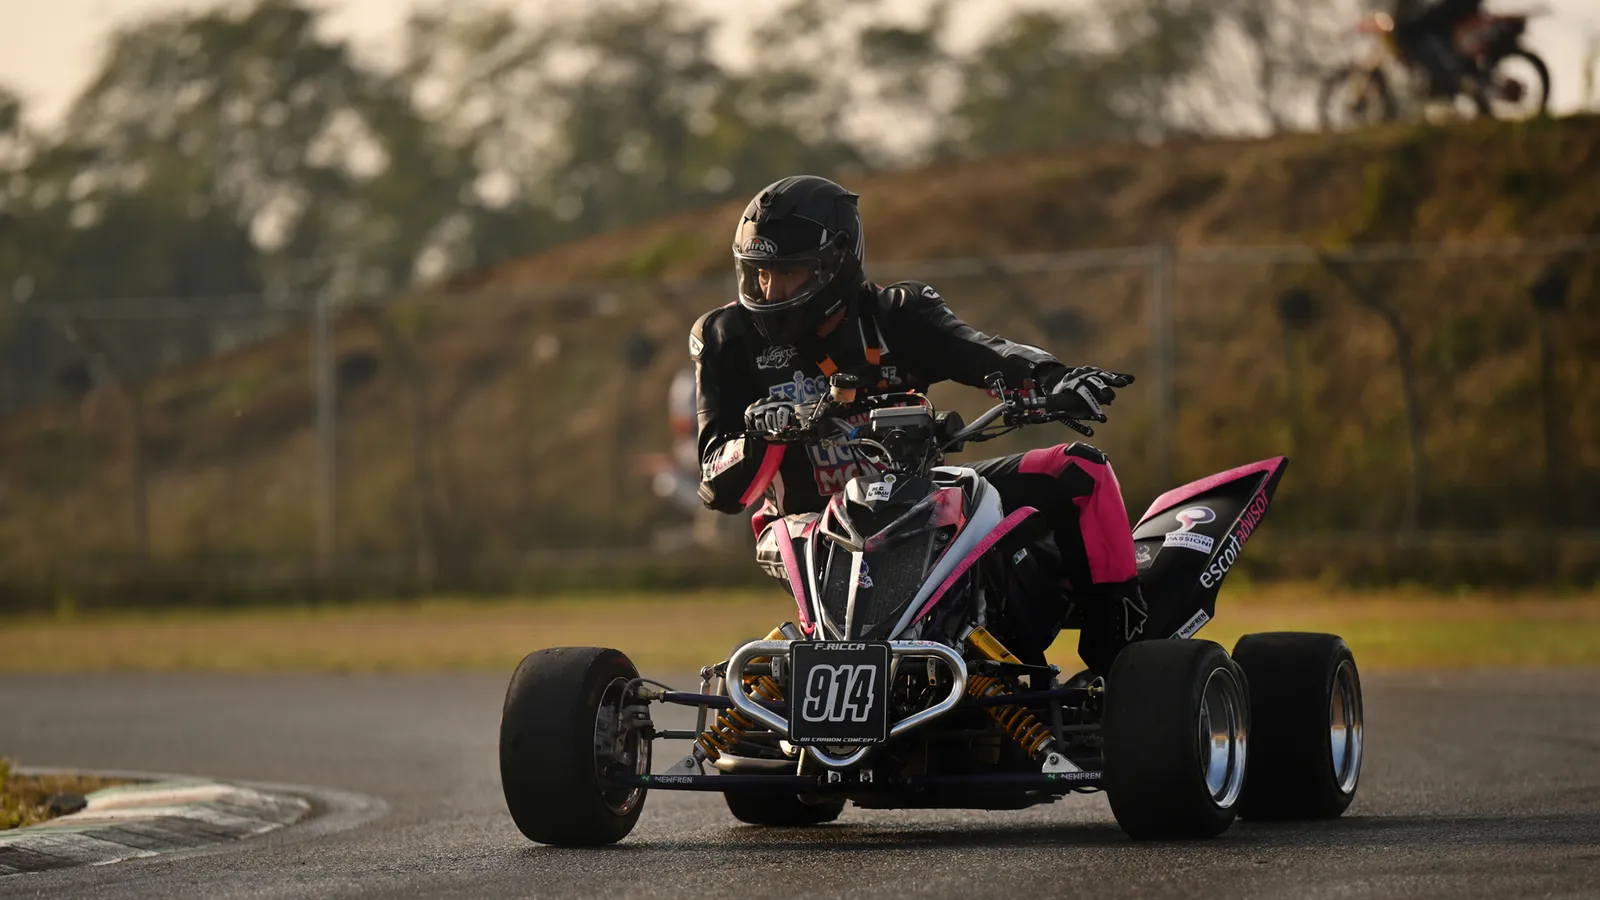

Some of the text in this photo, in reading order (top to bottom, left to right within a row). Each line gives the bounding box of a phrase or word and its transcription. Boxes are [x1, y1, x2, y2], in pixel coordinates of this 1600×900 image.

[744, 239, 774, 253] Airoh
[1167, 536, 1211, 548] PASSIONI
[1180, 611, 1207, 636] NEWFREN
[802, 664, 877, 722] 914
[653, 775, 693, 784] NEWFREN
[1060, 772, 1101, 780] NEWFREN
